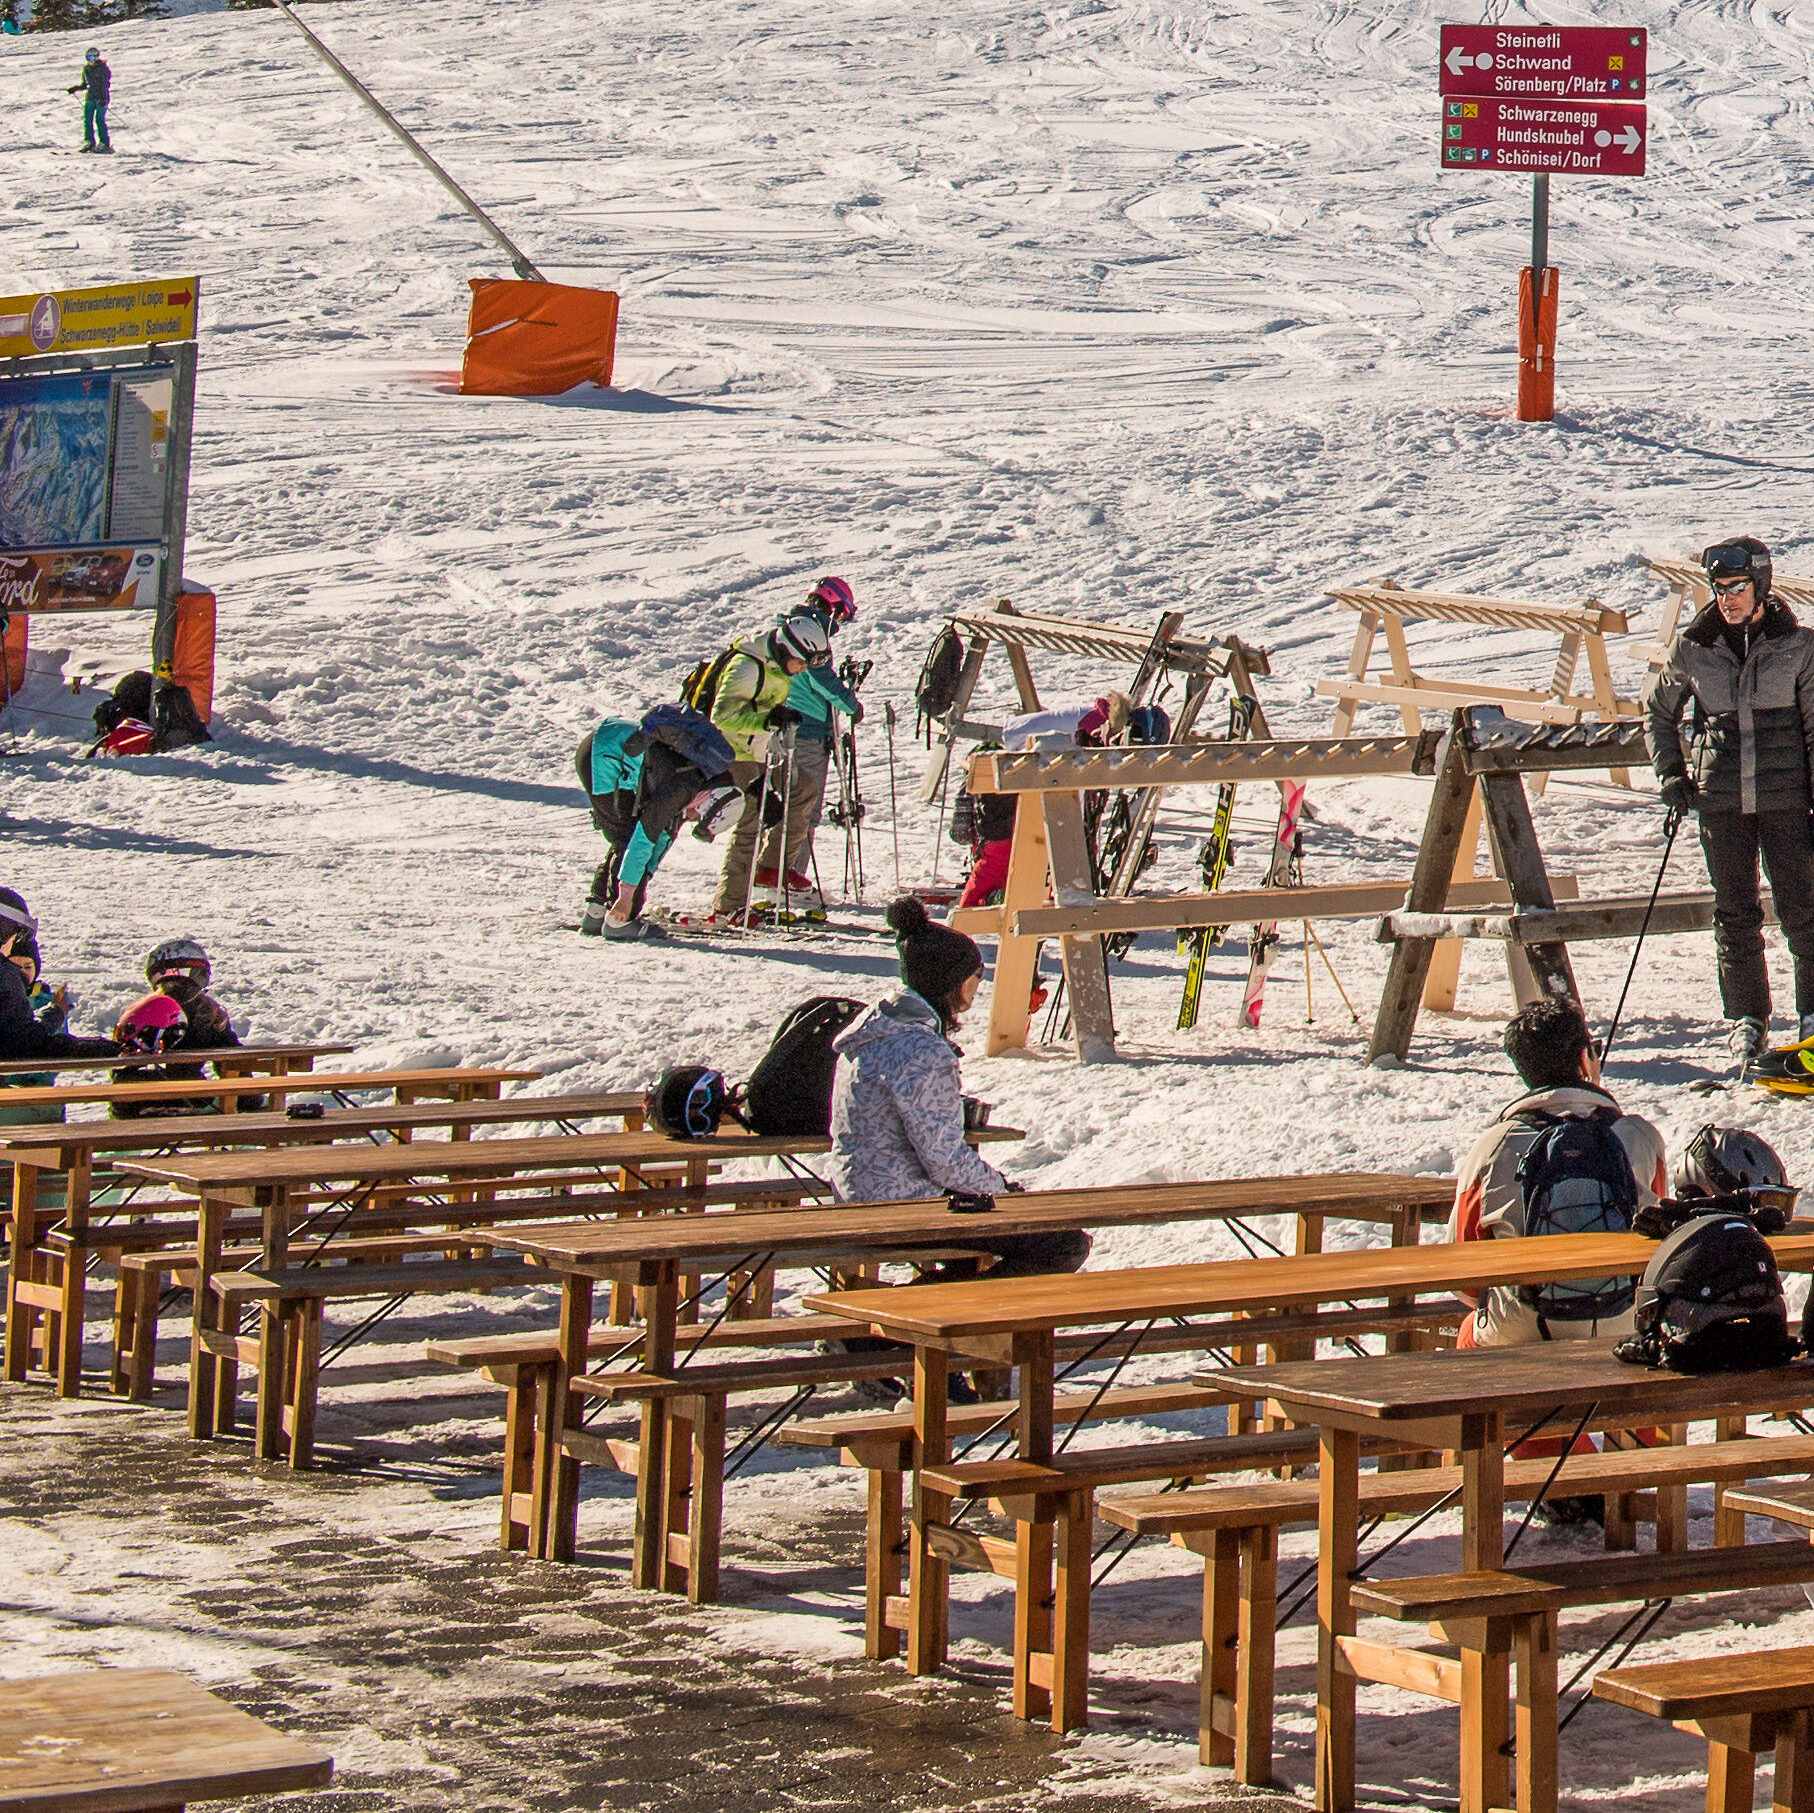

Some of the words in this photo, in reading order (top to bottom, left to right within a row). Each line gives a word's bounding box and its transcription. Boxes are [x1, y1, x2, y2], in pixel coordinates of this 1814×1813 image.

[1496, 32, 1561, 49] Steinetli
[1496, 55, 1572, 70] Schwand
[1495, 76, 1607, 96] Sörenberg/Platz
[1498, 105, 1598, 128] Schwarzenegg
[1497, 127, 1585, 145] Hundsknubel
[1496, 149, 1602, 168] Schönisei/Dorf
